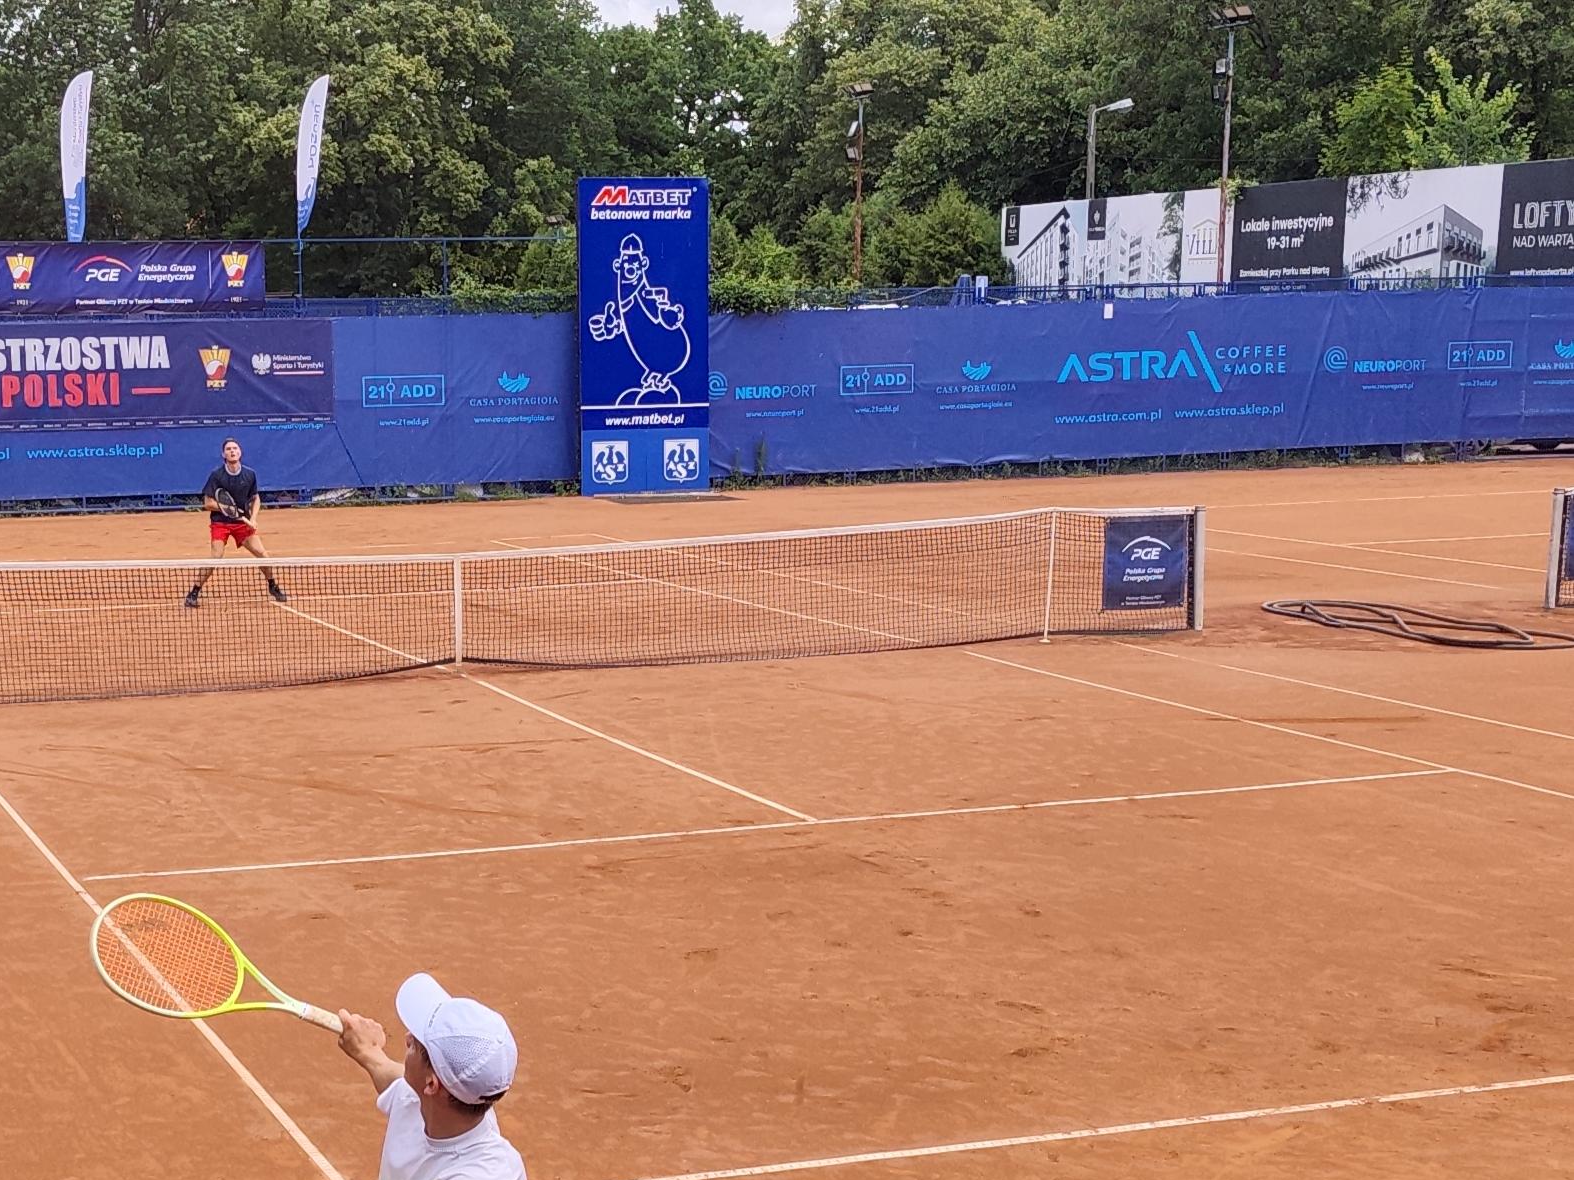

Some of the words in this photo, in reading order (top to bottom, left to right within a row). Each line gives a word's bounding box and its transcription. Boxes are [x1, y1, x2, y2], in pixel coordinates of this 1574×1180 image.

[590, 186, 692, 205] MATBET
[590, 208, 650, 220] betonowa
[652, 207, 692, 219] marka
[1513, 200, 1574, 229] LOFTY
[1241, 218, 1270, 232] Lokale
[1271, 213, 1334, 232] inwestycyjne
[1266, 236, 1289, 249] 19-31
[1513, 235, 1536, 248] NAD
[85, 268, 121, 281] PGE
[140, 264, 167, 272] Polska
[169, 264, 196, 273] Grupa
[138, 273, 194, 282] Energetyczna
[1215, 344, 1287, 360] COFFEE
[1476, 349, 1506, 361] ADD
[1056, 349, 1198, 383] ASTRA
[1353, 359, 1426, 373] NEUROPORT
[873, 373, 907, 386] ADD
[1, 372, 120, 408] POLSKI
[400, 384, 436, 398] ADD
[735, 384, 817, 400] NEUROPORT
[936, 386, 959, 394] CASA
[961, 383, 1016, 393] PORTAGIOIA
[469, 398, 495, 407] CASA
[498, 396, 559, 406] PORTAGIOIA
[605, 413, 685, 426] www.matbet.pl
[1054, 408, 1162, 424] www.astra.com.pl
[1175, 402, 1284, 418] www.astra.sklep.pl
[27, 443, 163, 459] www.astra.sklep.pl
[1130, 547, 1161, 561] PGE
